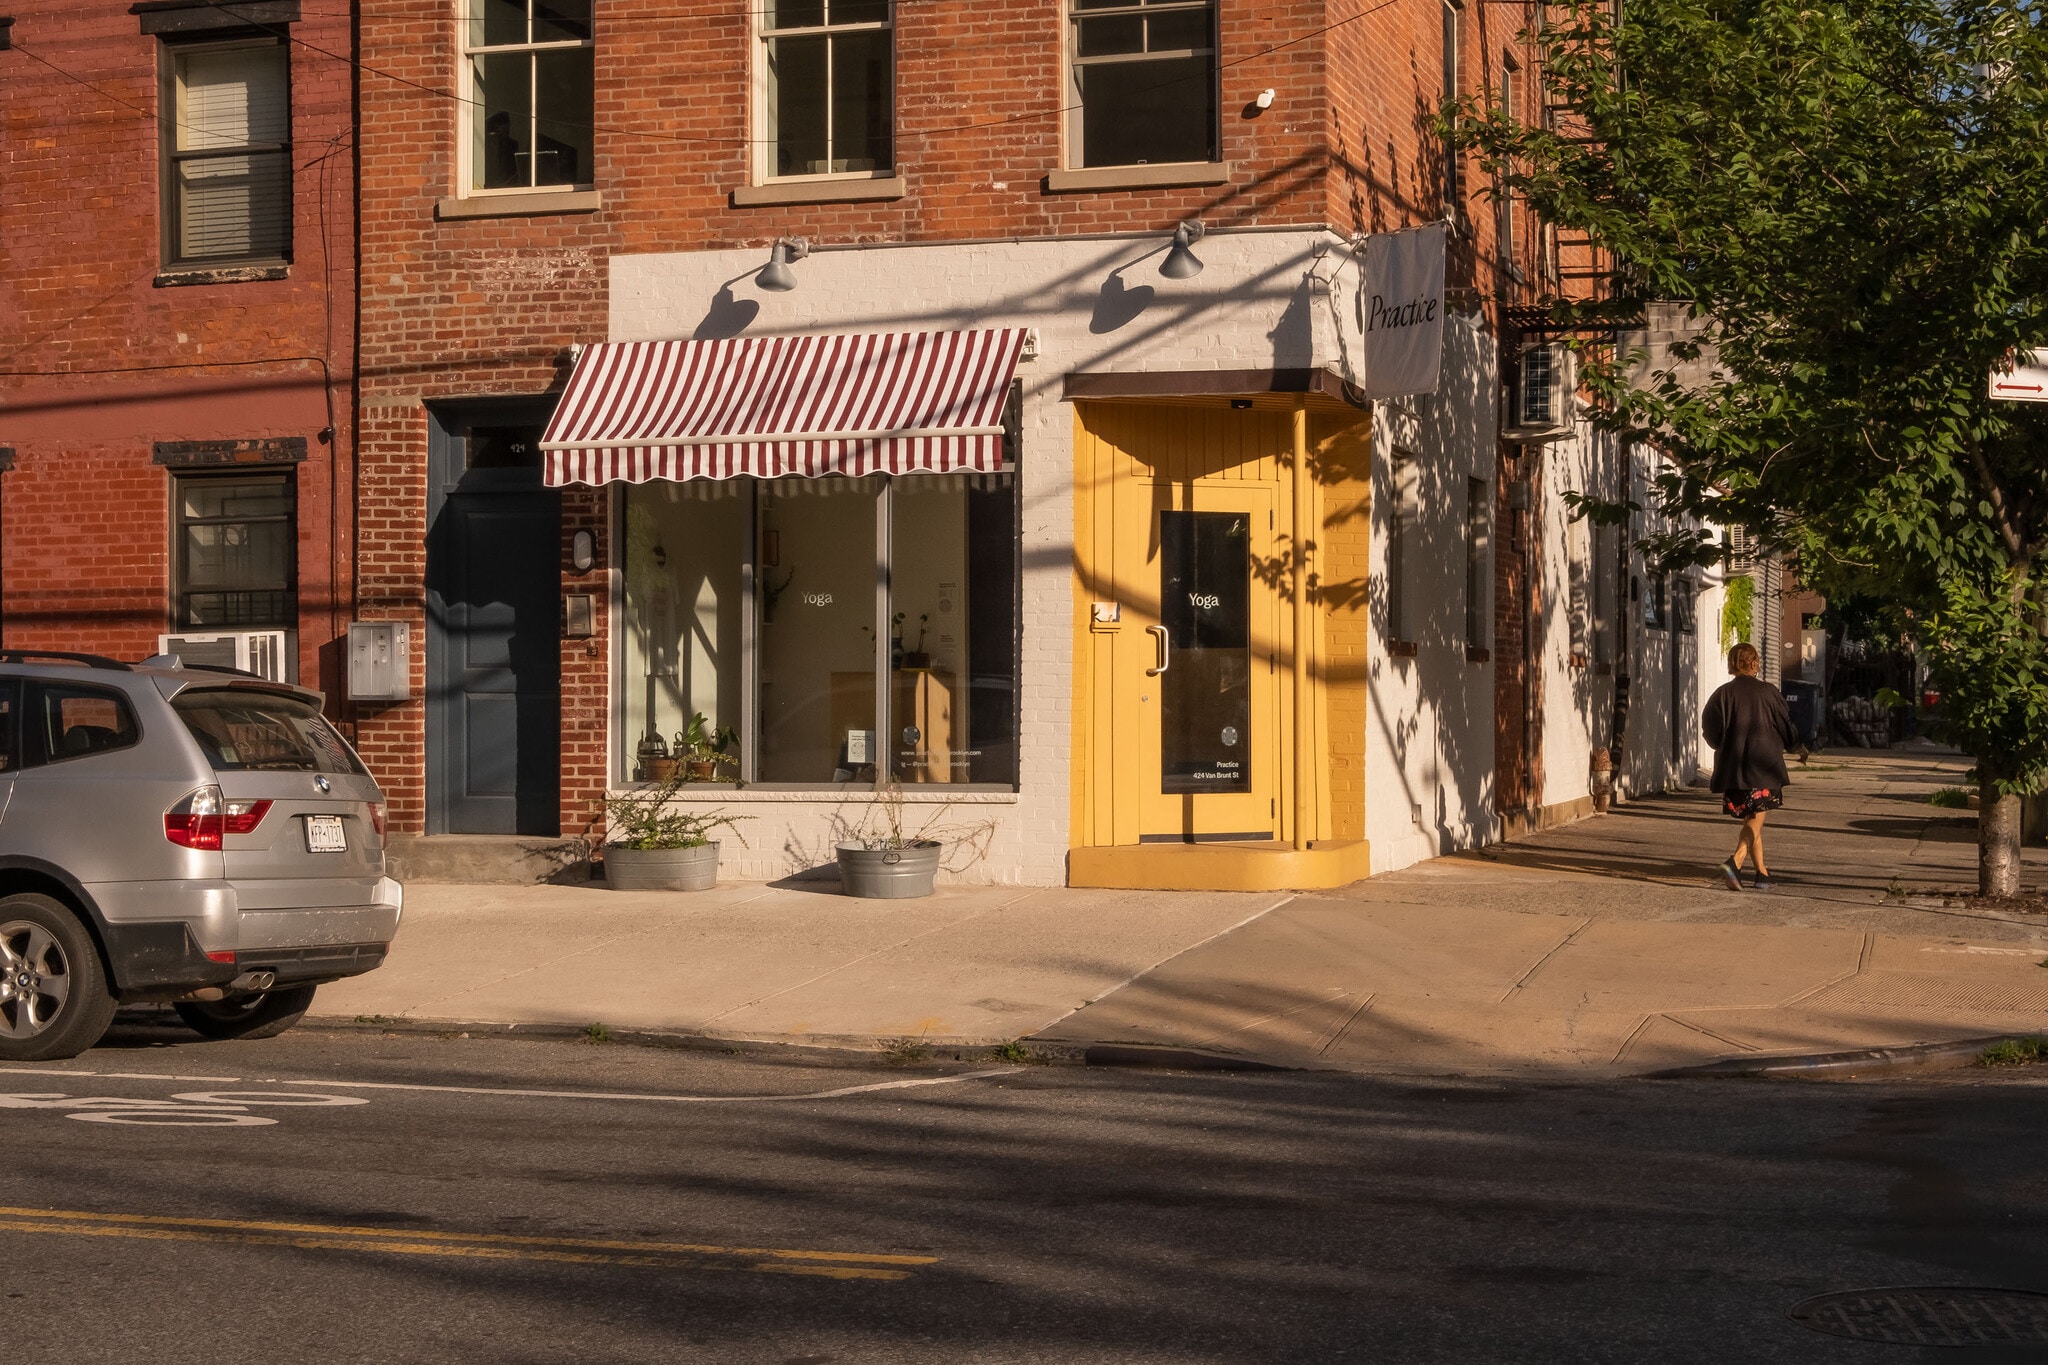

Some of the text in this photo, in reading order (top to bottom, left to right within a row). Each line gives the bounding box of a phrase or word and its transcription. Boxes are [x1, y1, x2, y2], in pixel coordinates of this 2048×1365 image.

[1367, 293, 1437, 332] Practice
[510, 443, 526, 453] 424
[800, 591, 833, 607] Yoga
[1188, 592, 1220, 609] Yoga
